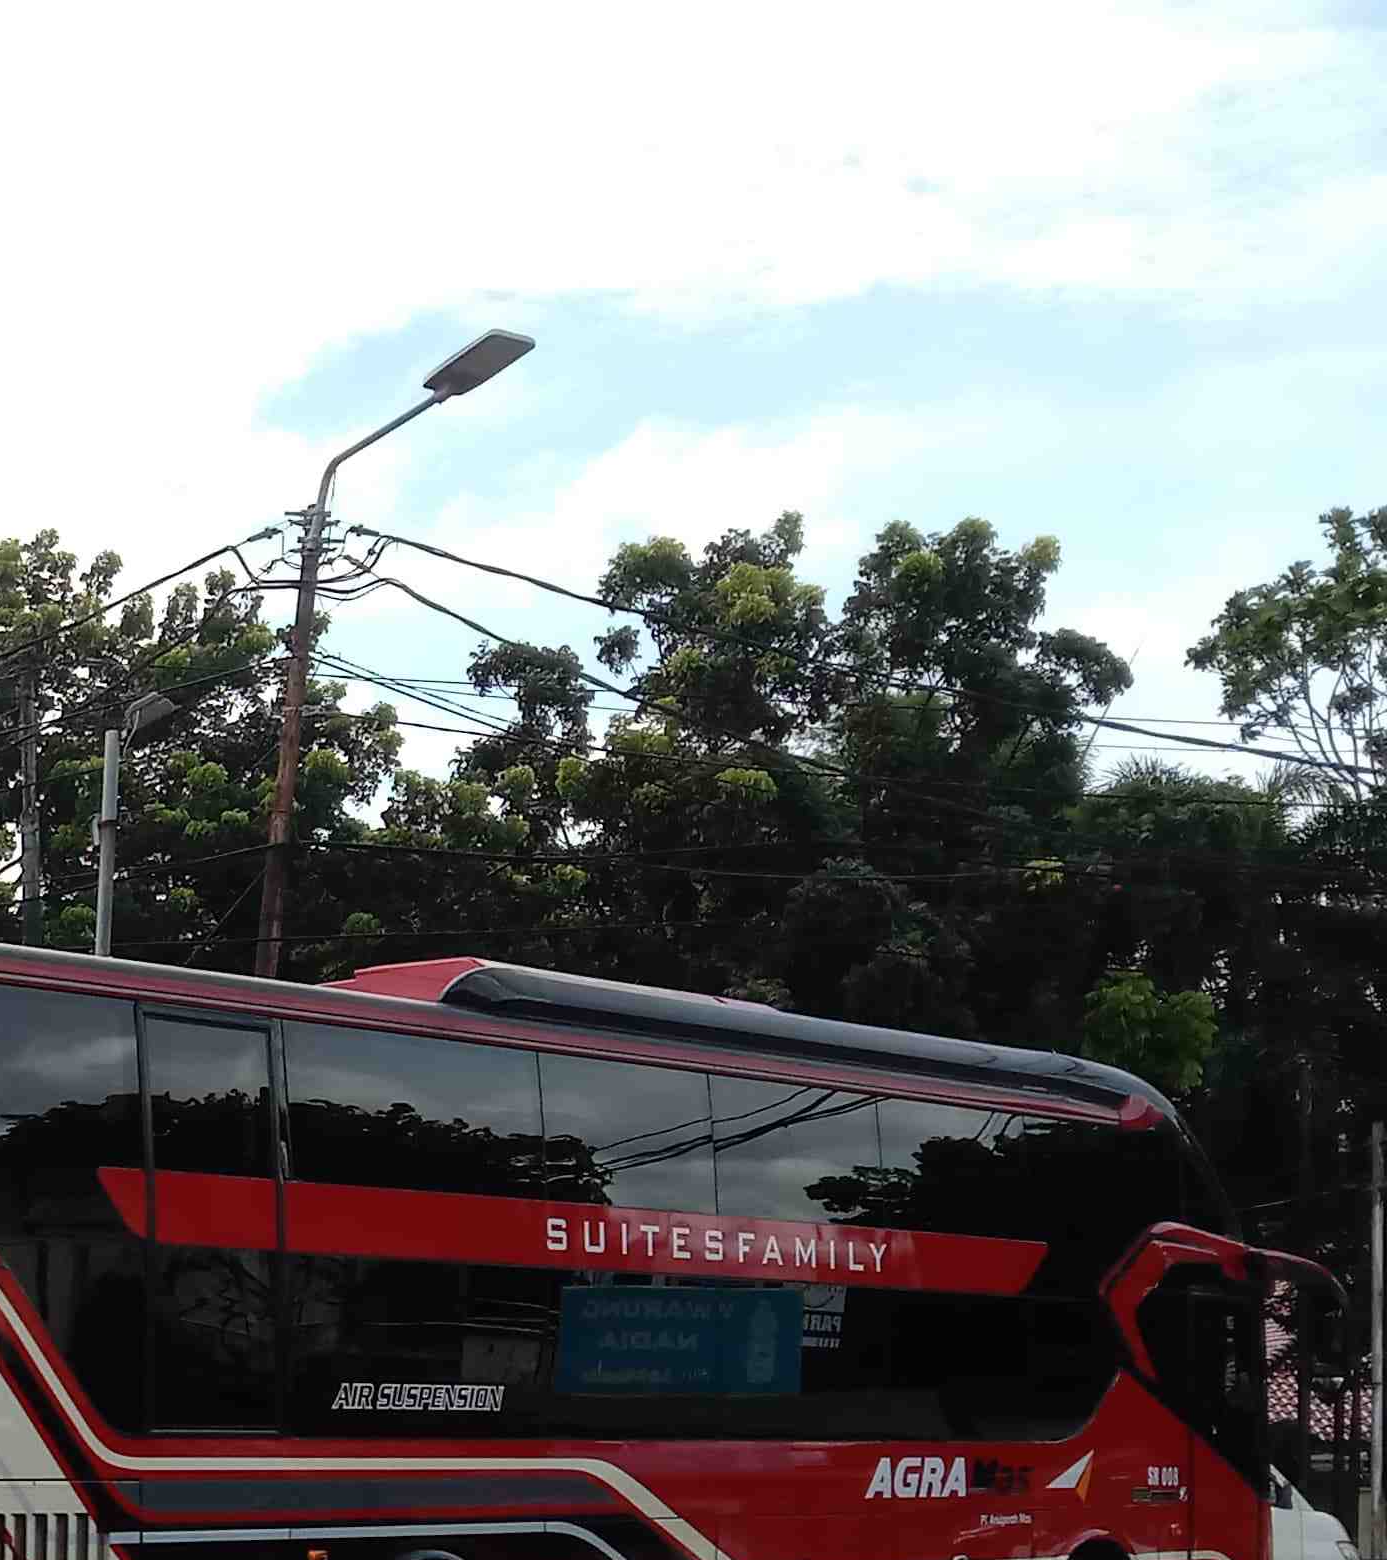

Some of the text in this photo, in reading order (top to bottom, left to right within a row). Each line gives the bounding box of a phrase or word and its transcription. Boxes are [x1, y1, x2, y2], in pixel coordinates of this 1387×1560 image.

[331, 1383, 505, 1411] AIR SUSPENSION
[865, 1456, 967, 1499] AGRA
